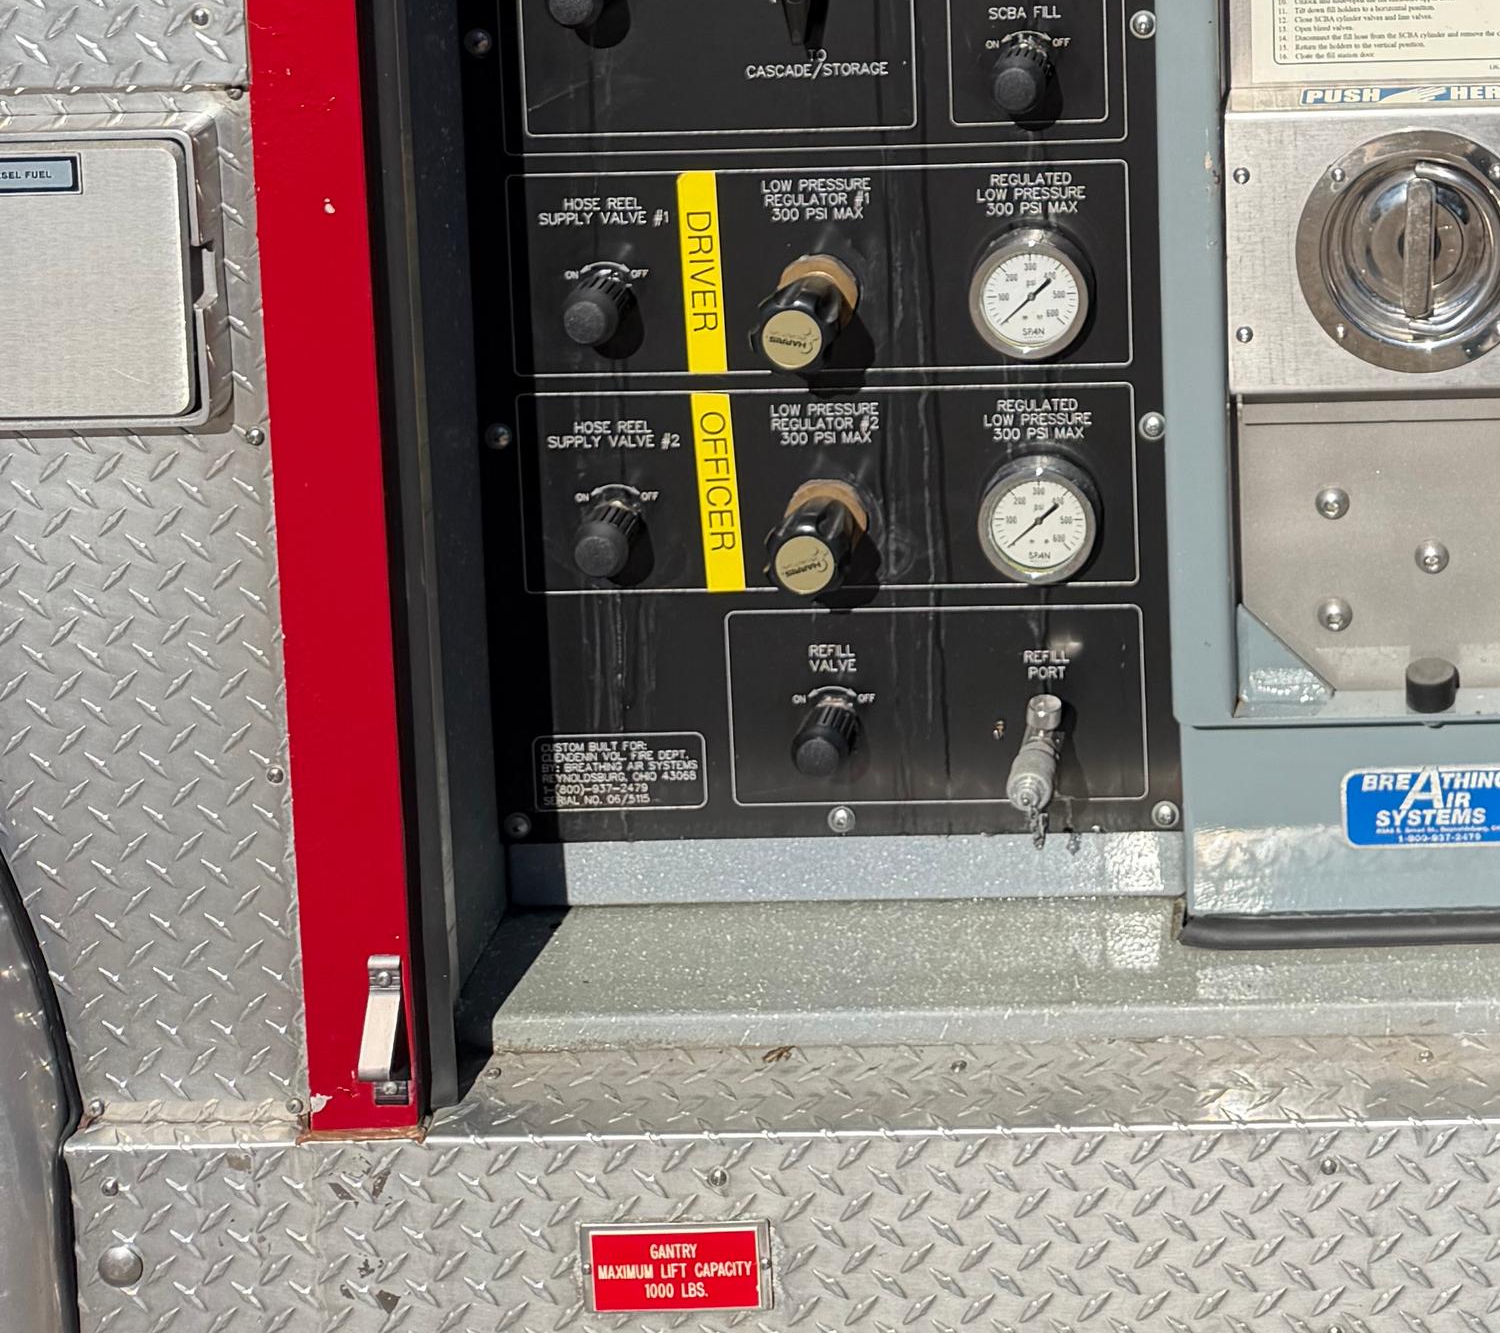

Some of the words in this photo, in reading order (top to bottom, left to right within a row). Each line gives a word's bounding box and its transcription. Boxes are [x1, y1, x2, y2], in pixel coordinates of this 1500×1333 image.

[989, 7, 1027, 20] SCBA
[1033, 6, 1061, 19] FILL
[986, 40, 999, 49] ON
[1053, 38, 1071, 47] OFF
[809, 49, 827, 62] TO
[746, 62, 888, 79] CASCADE/STORAGE
[1306, 88, 1381, 102] PUSH
[0, 171, 21, 179] SEL
[25, 171, 52, 179] FUEL
[991, 172, 1072, 187] REGULATED
[762, 180, 792, 193] LOW
[799, 178, 871, 192] PRESSURE
[765, 193, 848, 207] REGULATOR
[854, 191, 870, 209] #1
[977, 189, 1007, 203] LOW
[1014, 186, 1085, 200] PRESSURE
[564, 198, 600, 211] HOSE
[608, 197, 642, 210] REEL
[986, 203, 1013, 215] 300
[1021, 202, 1042, 214] PSI
[1049, 201, 1078, 213] MAX
[539, 212, 593, 226] SUPPLY
[601, 212, 647, 225] VALVE
[653, 209, 669, 227] #1
[772, 208, 799, 221] 300
[806, 207, 828, 220] PSI
[834, 207, 863, 220] MAX
[565, 270, 579, 280] ON
[631, 269, 648, 279] OFF
[686, 211, 718, 332] DRIVER
[771, 404, 801, 417] LOW
[807, 403, 879, 415] PRESSURE
[997, 399, 1078, 412] REGULATED
[772, 417, 853, 431] REGULATOR
[860, 415, 879, 433] #2
[983, 414, 1014, 427] LOW
[1021, 412, 1092, 426] PRESSURE
[574, 422, 611, 434] HOSE
[618, 421, 652, 433] REEL
[993, 428, 1020, 440] 300
[1027, 427, 1048, 439] PSI
[1055, 427, 1084, 439] MAX
[547, 435, 600, 449] SUPPLY
[610, 435, 654, 448] VALVE
[662, 433, 680, 449] #2
[781, 432, 806, 446] 300
[813, 432, 836, 445] PSI
[842, 431, 872, 443] MAX
[700, 411, 735, 552] OFFICER
[575, 493, 589, 502] ON
[640, 491, 659, 501] OFF
[809, 644, 856, 658] REFILL
[1024, 651, 1069, 665] REFILL
[809, 658, 857, 673] VALVE
[1028, 666, 1066, 680] PORT
[792, 695, 806, 704] ON
[858, 693, 875, 703] OFF
[541, 743, 584, 752] CUSTOM
[589, 742, 617, 751] BUILT
[622, 741, 647, 750] FOR:
[603, 752, 626, 760] VOL.
[631, 751, 653, 760] FIRE
[658, 750, 689, 760] DEPT.
[542, 763, 560, 773] BY:
[564, 762, 622, 772] BREATHING
[627, 762, 644, 770] AIR
[649, 760, 698, 770] SYSTEMS
[632, 772, 657, 781] OHIO
[662, 772, 696, 781] 43068
[544, 796, 580, 806] SERIAL
[584, 796, 602, 805] NO.
[607, 794, 650, 805] 06/5115
[1376, 808, 1486, 827] SYSTEMS
[650, 1244, 697, 1259] GANTRY
[598, 1264, 653, 1279] MAXIMUM
[661, 1263, 687, 1278] LIFT
[694, 1261, 752, 1277] CAPACITY
[645, 1283, 674, 1298] 1000
[682, 1283, 708, 1298] LBS.
